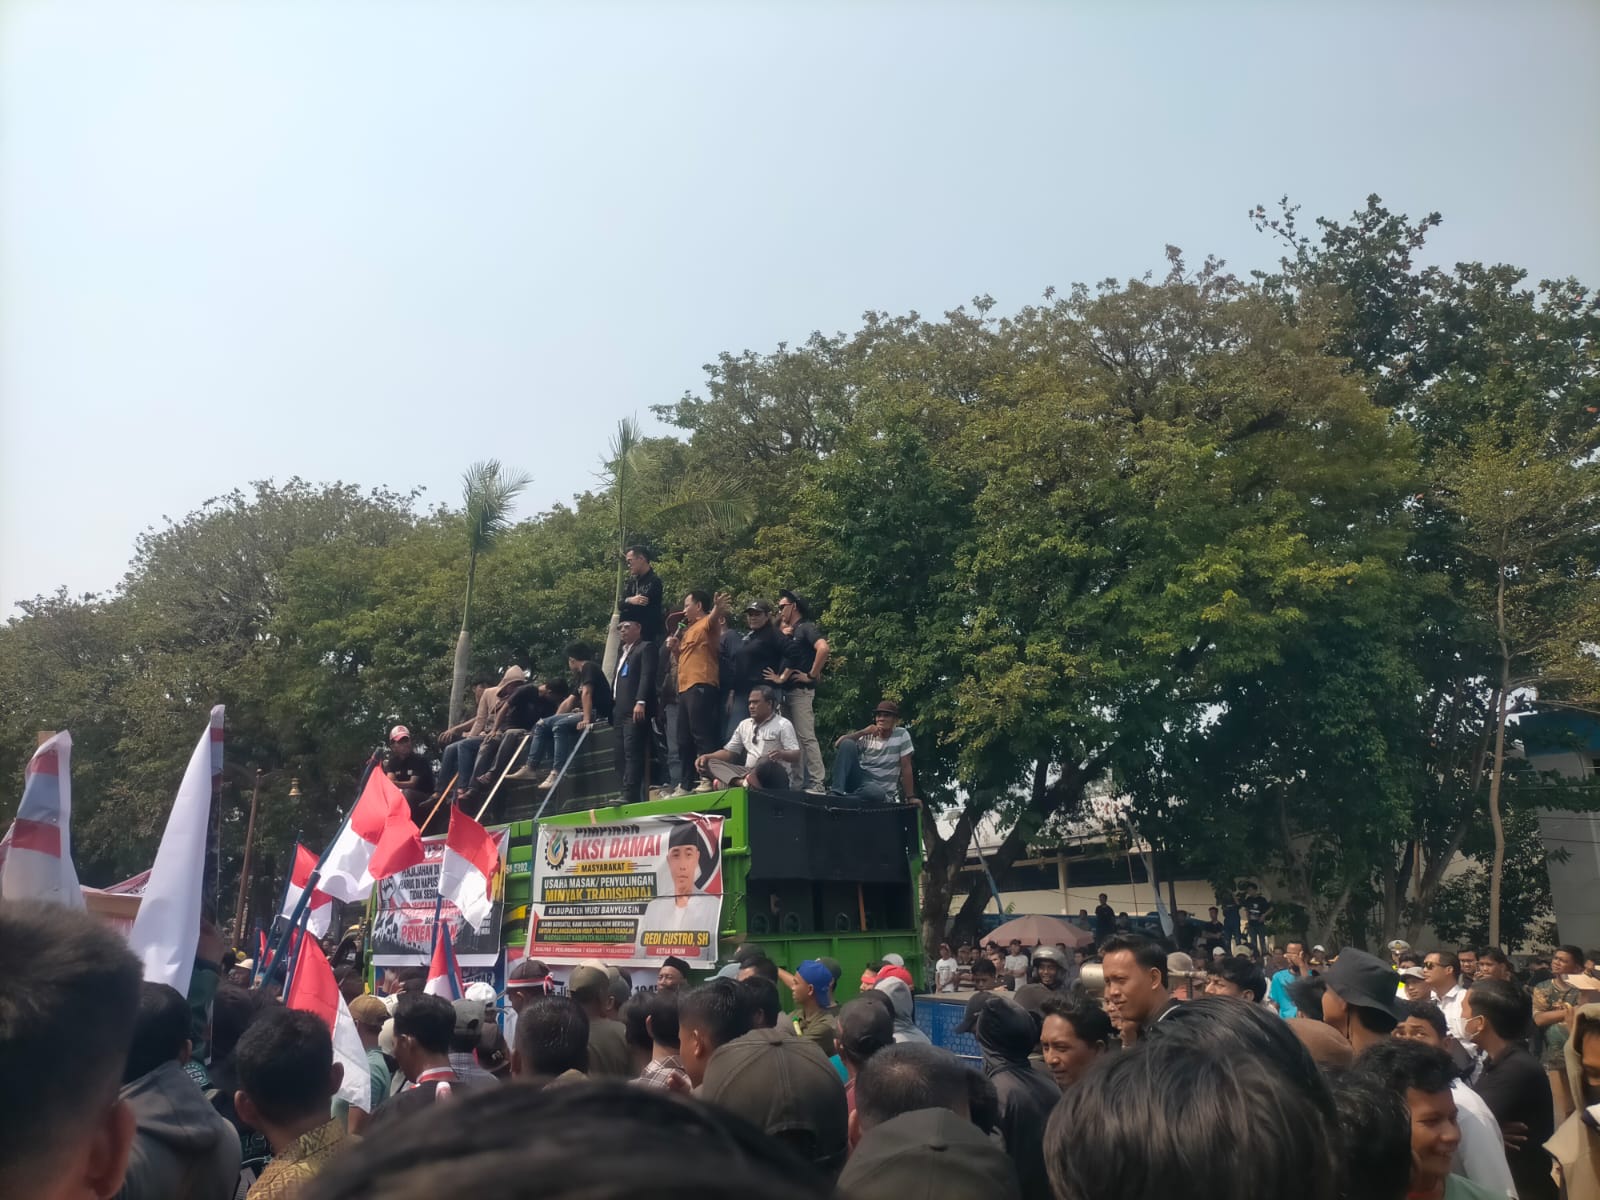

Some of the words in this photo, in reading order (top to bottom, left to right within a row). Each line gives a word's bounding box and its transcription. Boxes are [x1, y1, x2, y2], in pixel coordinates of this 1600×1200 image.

[571, 837, 606, 860] AKSI
[609, 835, 662, 858] DAMAI
[581, 863, 625, 872] MASYARAKAT
[544, 878, 568, 889] USAHA
[600, 875, 654, 887] PENYULINGAN
[410, 890, 423, 900] TIDAK
[545, 888, 583, 902] MINYAK
[548, 906, 583, 915] KABUPATEN
[584, 906, 600, 914] MUSI
[601, 905, 640, 914] BANYUASIN
[401, 924, 458, 942] PRIKEAN
[643, 932, 661, 945] REDI
[662, 932, 695, 946] GUSTRO,
[697, 932, 709, 945] SH
